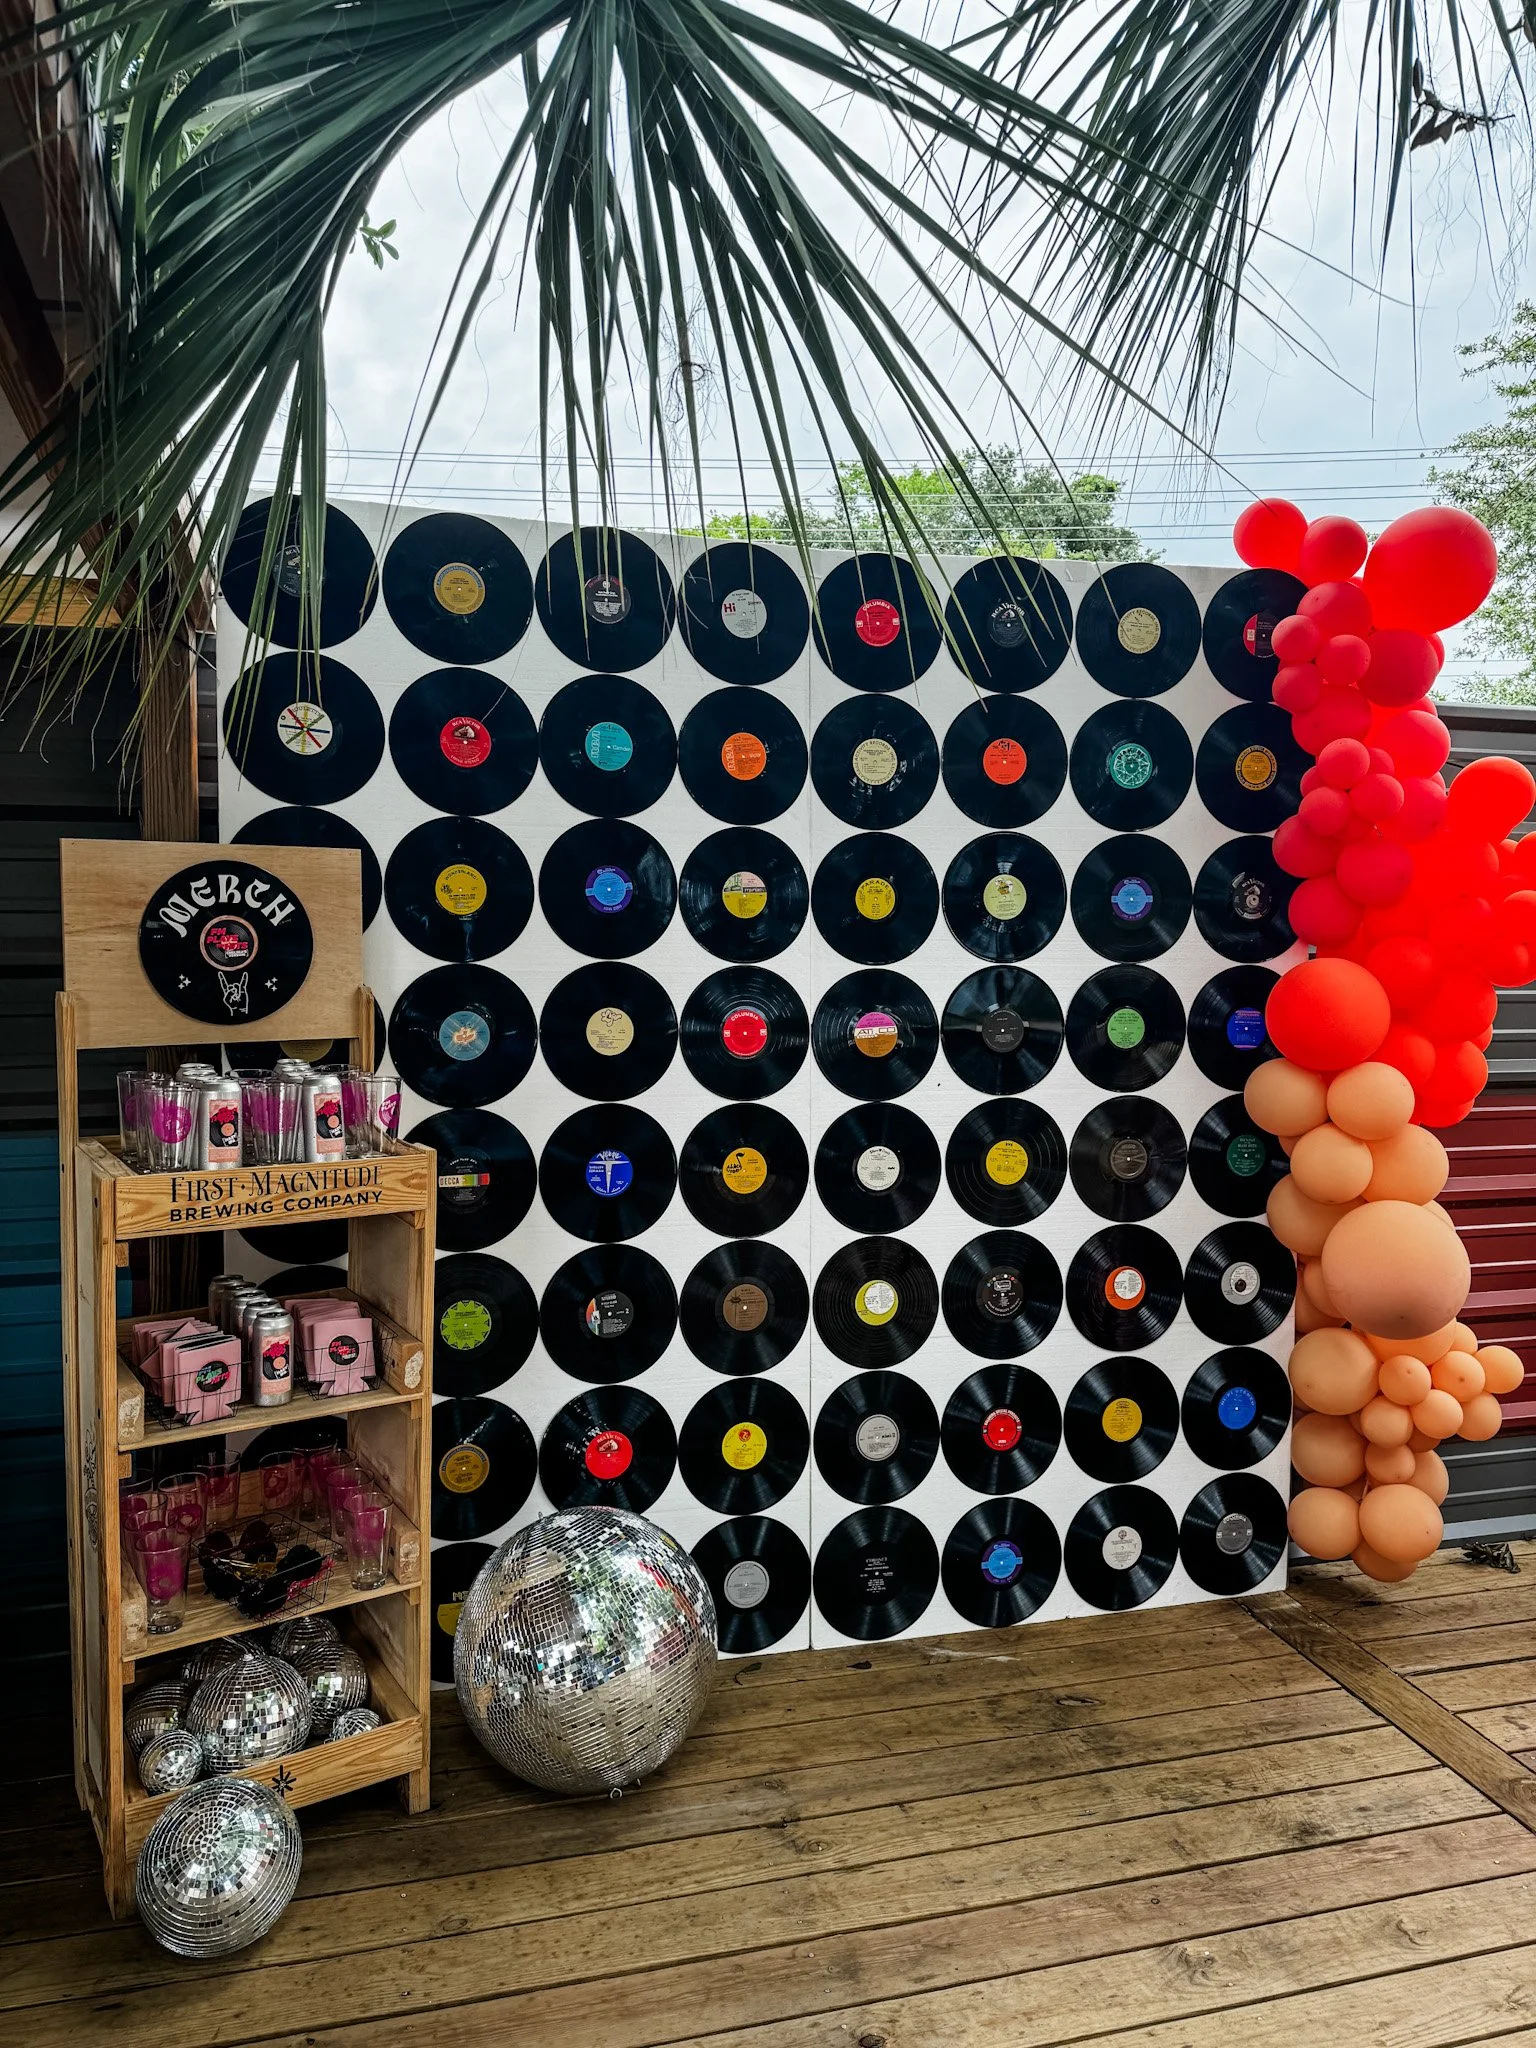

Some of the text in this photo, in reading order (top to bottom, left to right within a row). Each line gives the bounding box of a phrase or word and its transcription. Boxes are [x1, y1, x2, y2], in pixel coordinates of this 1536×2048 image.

[723, 602, 735, 612] Hi
[862, 601, 891, 611] COLUMBIA
[991, 602, 1026, 618] RCA VICTOR
[451, 717, 481, 730] RCA VICTOR
[861, 880, 890, 890] PARADE
[160, 874, 296, 938] MERCH
[210, 927, 227, 935] FM
[206, 934, 239, 943] PLAYS
[731, 1012, 760, 1022] COLUMBIA
[171, 1165, 383, 1203] FIRST MAGNITUDE
[440, 1177, 460, 1186] DECCA
[170, 1190, 383, 1222] BREWING COMPANY
[195, 1368, 223, 1383] PLAYS
[606, 1433, 623, 1442] VICTOR
